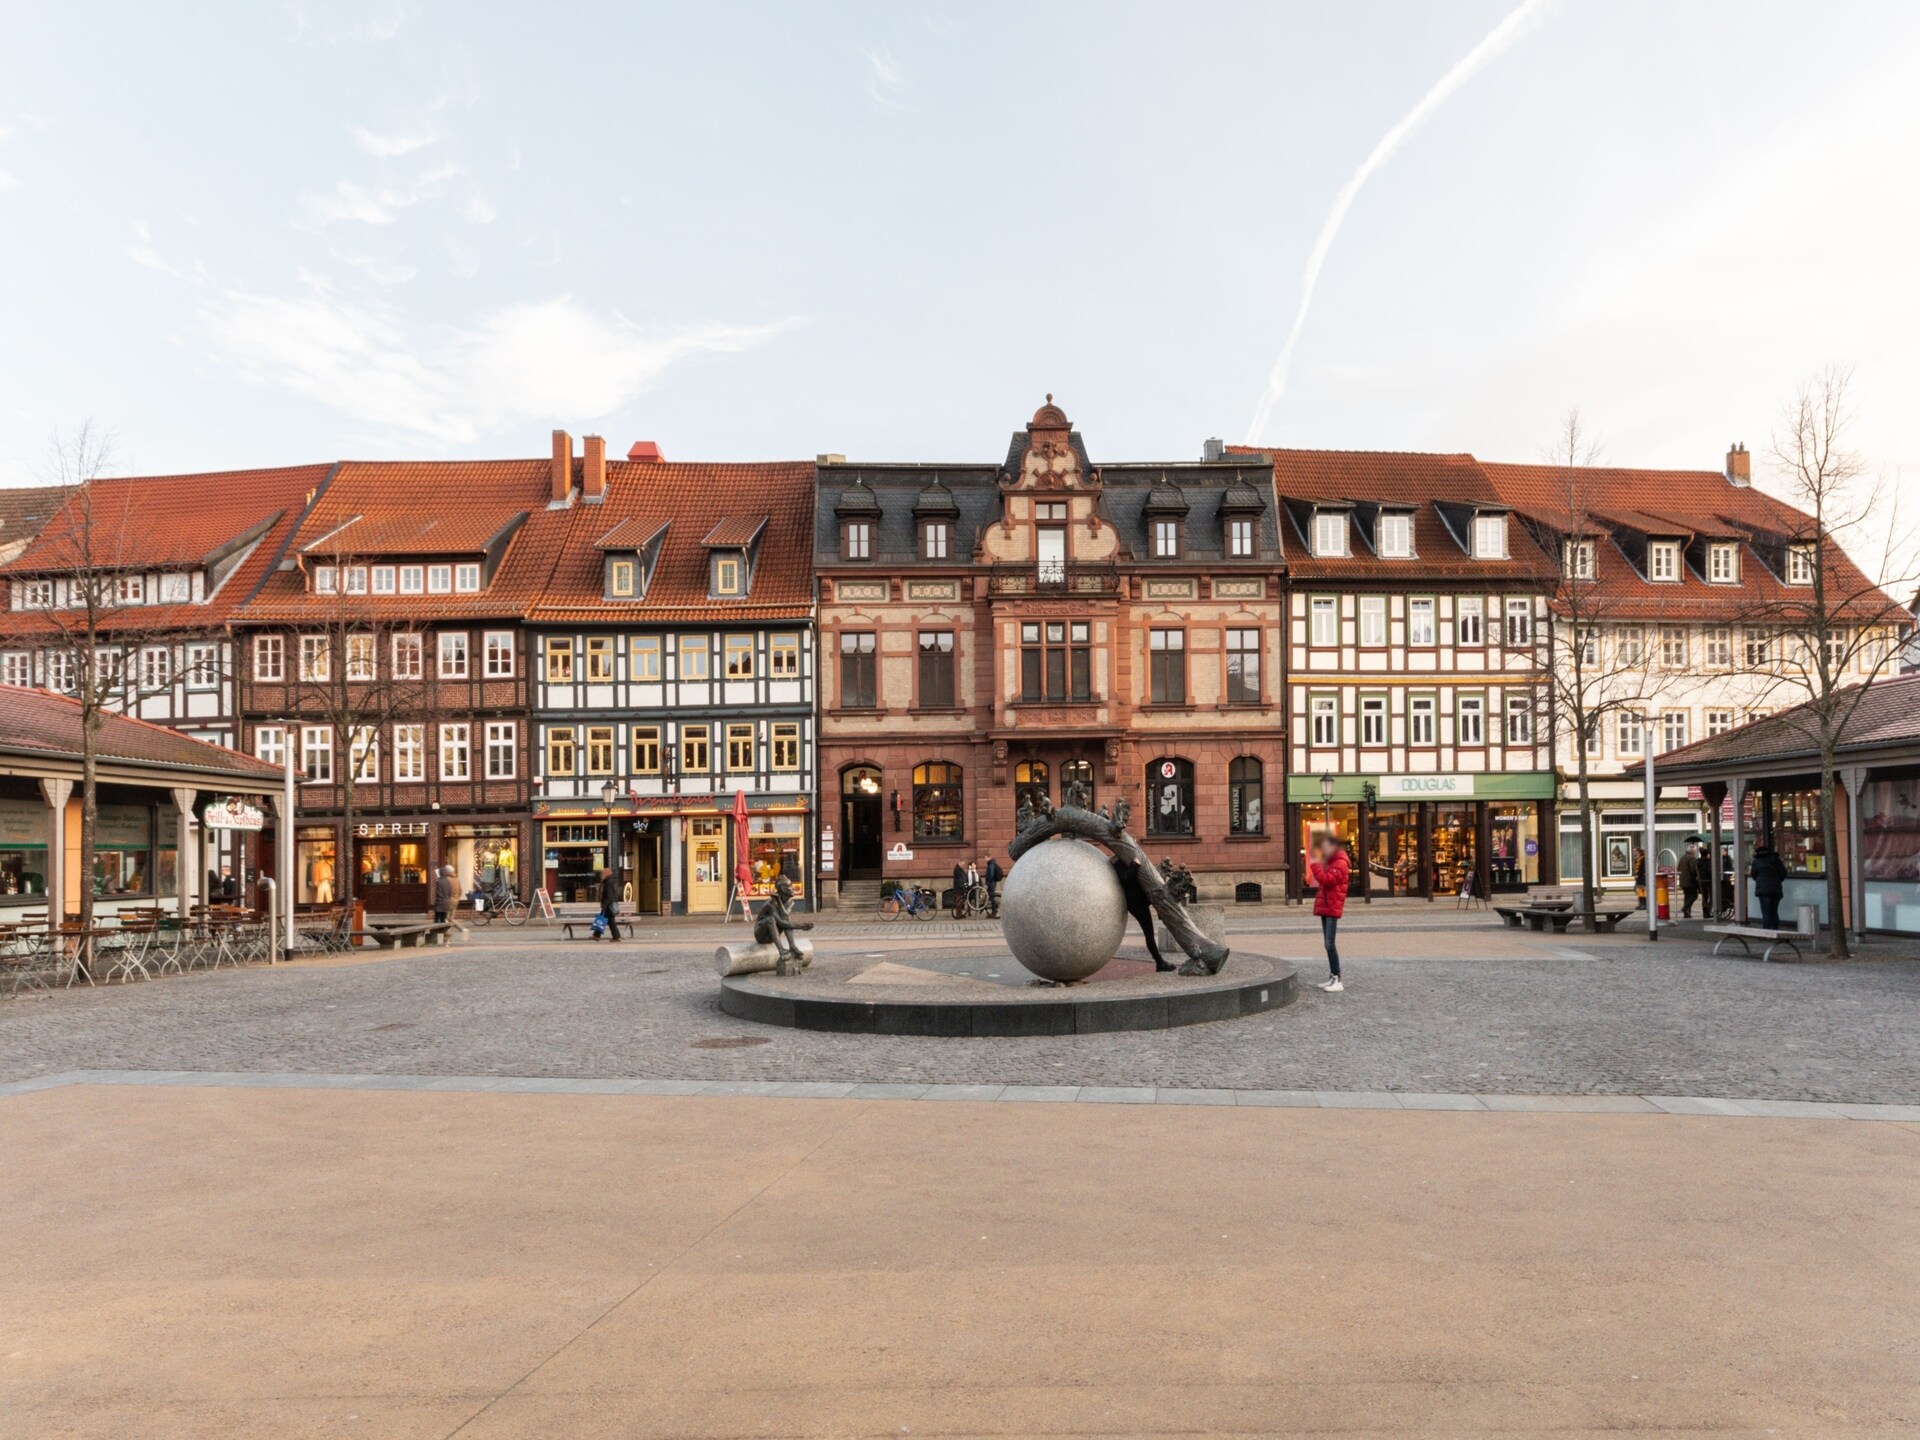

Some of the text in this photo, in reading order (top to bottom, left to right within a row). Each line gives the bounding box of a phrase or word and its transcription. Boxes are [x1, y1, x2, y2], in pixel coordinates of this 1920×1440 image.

[1401, 777, 1456, 791] DOUGLAS
[628, 786, 715, 814] Brauhaus
[1232, 786, 1240, 828] APOTHEKE
[359, 822, 429, 836] SPRIT
[632, 820, 648, 831] sky
